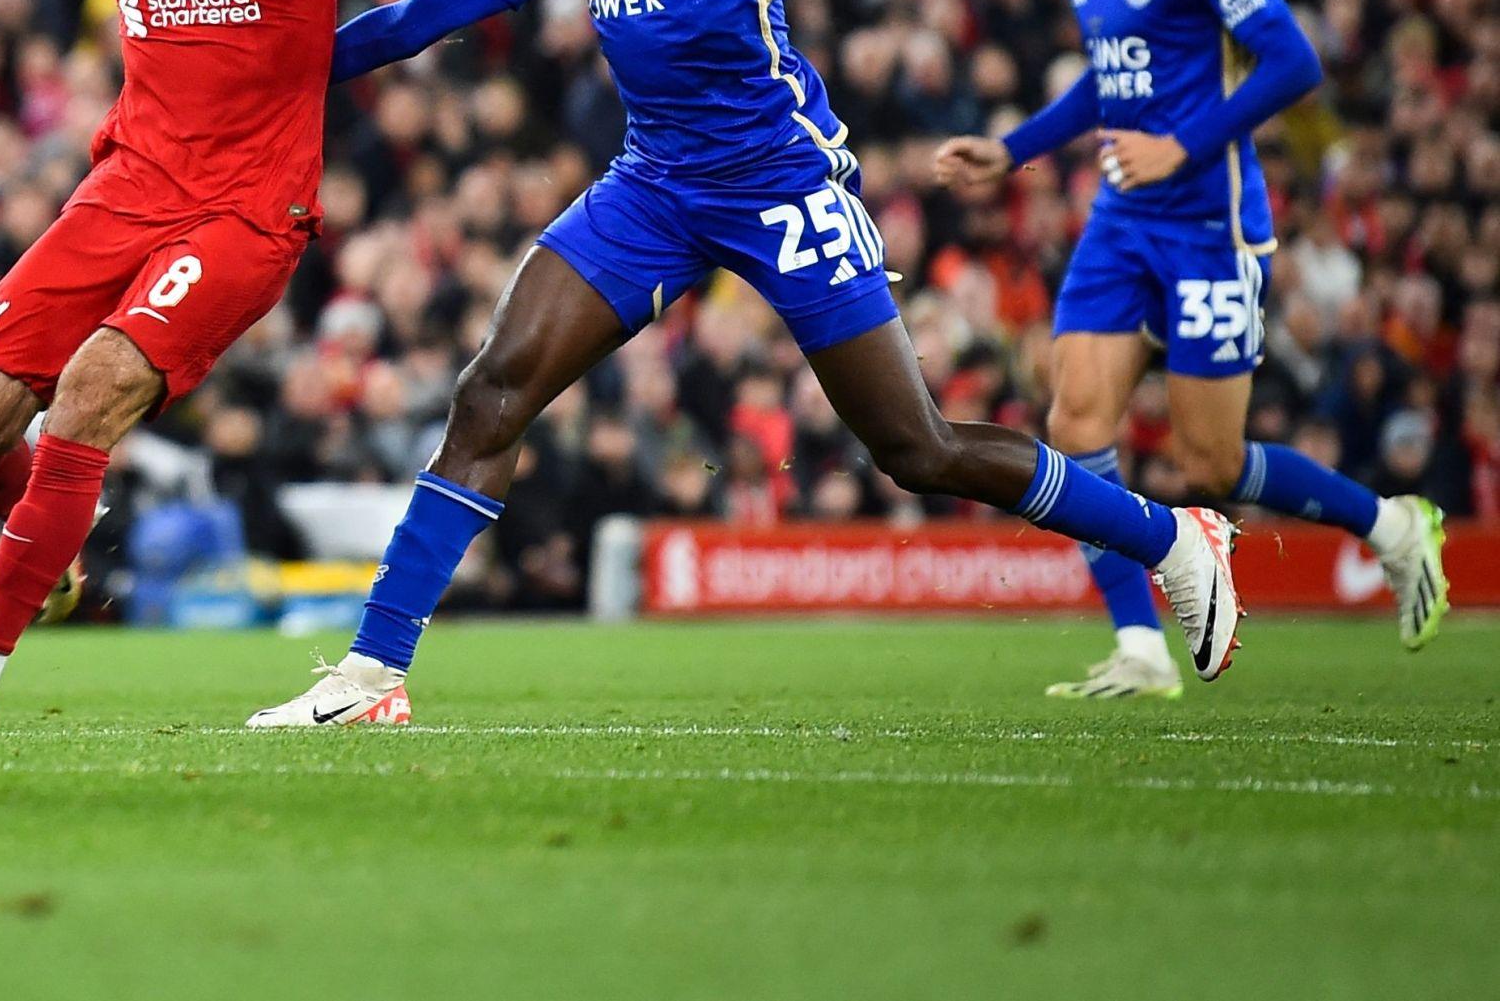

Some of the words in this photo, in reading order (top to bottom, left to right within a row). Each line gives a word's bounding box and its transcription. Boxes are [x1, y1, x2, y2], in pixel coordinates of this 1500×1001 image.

[150, 1, 261, 28] chartered
[760, 188, 851, 274] 25
[148, 255, 202, 308] 8
[1176, 280, 1248, 341] 35
